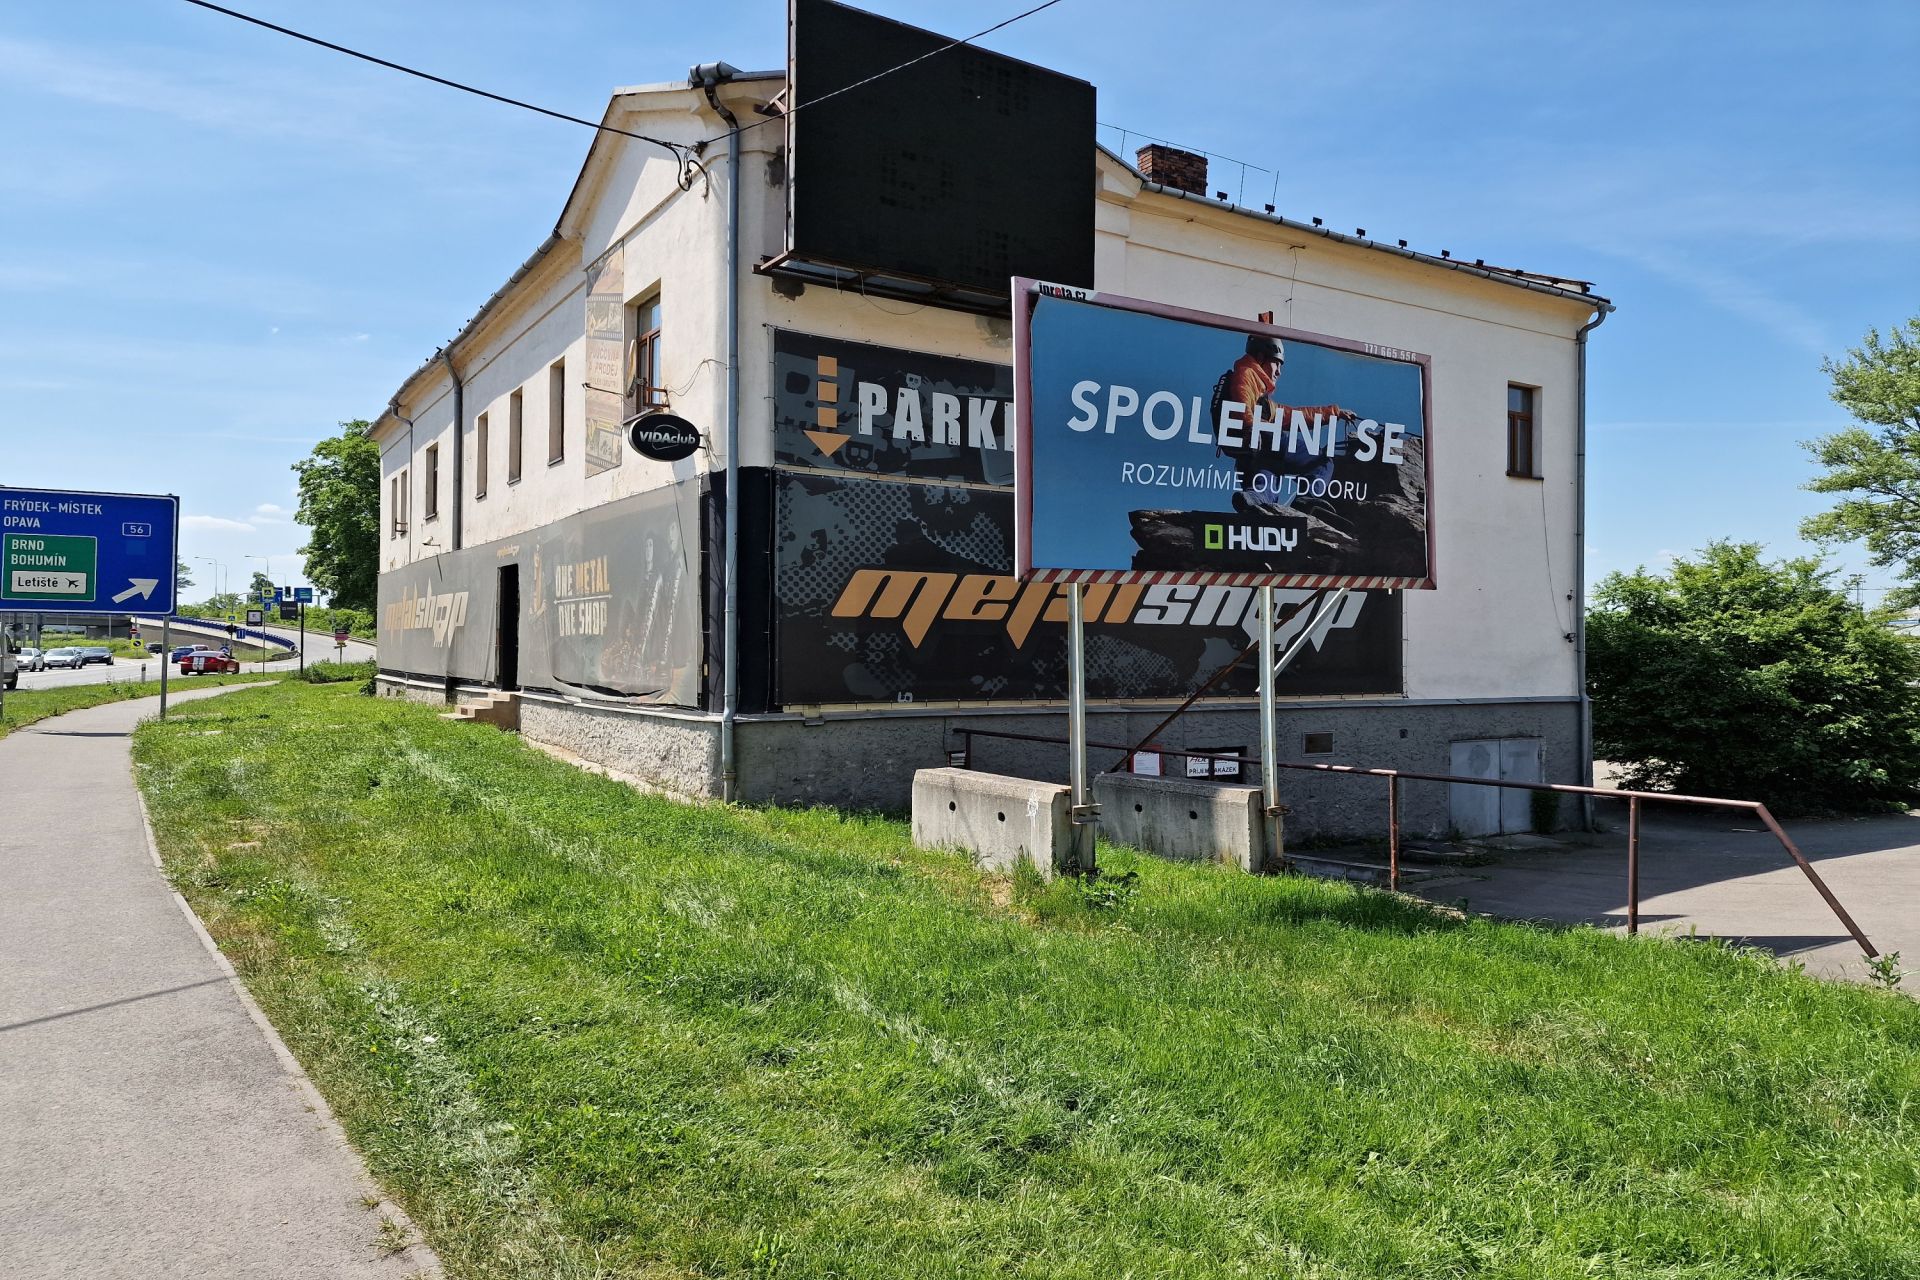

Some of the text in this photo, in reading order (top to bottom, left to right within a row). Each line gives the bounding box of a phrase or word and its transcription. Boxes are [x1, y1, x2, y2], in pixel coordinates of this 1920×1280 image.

[1364, 343, 1416, 362] 777 665 556
[1067, 380, 1338, 458] SPOLEHNI
[1355, 418, 1405, 465] SE
[640, 431, 696, 445] VIDAclub
[1121, 462, 1368, 501] ROZUMÍME OUTDOORU
[4, 498, 102, 515] FRÝDEK-MÍSTEK
[3, 516, 41, 528] OPAVA
[130, 525, 144, 534] 56
[12, 539, 45, 551] BRNO
[1229, 525, 1298, 552] HUDY
[11, 552, 66, 567] BOHUMÍN
[18, 577, 59, 588] Letiště
[555, 555, 610, 598] ONE METAL
[558, 601, 608, 637] ONE SHOP
